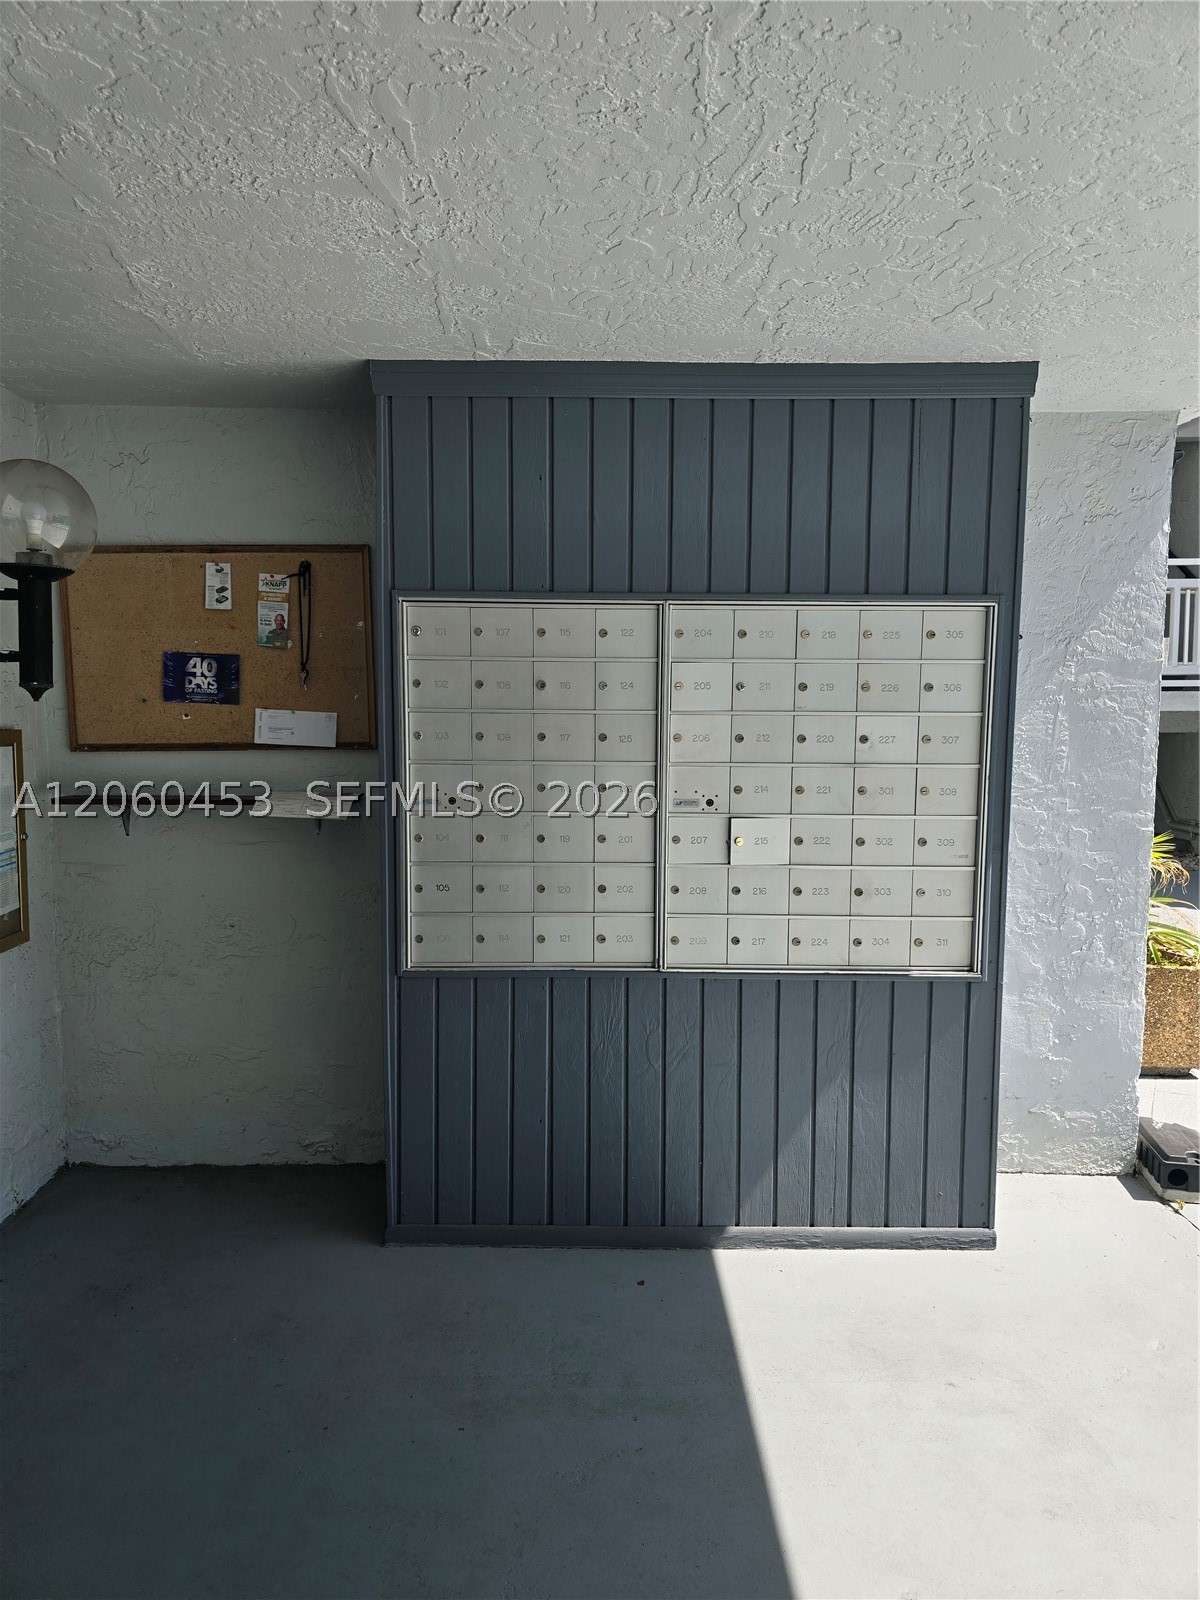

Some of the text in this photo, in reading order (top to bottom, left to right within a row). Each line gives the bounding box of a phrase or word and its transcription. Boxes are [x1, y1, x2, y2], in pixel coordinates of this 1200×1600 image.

[265, 581, 287, 589] KNAPP
[435, 628, 446, 636] 101
[496, 628, 510, 636] 107
[560, 629, 571, 637] 115
[621, 629, 634, 637] 122
[693, 629, 712, 638] 204
[758, 630, 773, 639] 210
[821, 631, 836, 639] 218
[882, 631, 901, 639] 225
[945, 630, 964, 639] 305
[185, 657, 218, 677] 40
[185, 676, 218, 689] DAYS
[434, 680, 448, 688] 102
[496, 681, 511, 689] 108
[560, 682, 571, 690] 116
[620, 682, 634, 690] 124
[693, 682, 711, 690] 205
[758, 682, 770, 691] 211
[819, 683, 834, 691] 219
[881, 684, 899, 692] 226
[943, 684, 962, 692] 306
[435, 732, 449, 740] 103
[497, 733, 511, 741] 109
[619, 735, 632, 743] 125
[692, 734, 710, 742] 206
[756, 734, 770, 742] 212
[816, 735, 834, 743] 220
[878, 735, 896, 743] 227
[941, 736, 959, 744] 307
[754, 785, 769, 793] 214
[816, 786, 831, 794] 221
[878, 787, 894, 795] 301
[938, 787, 957, 795] 308
[500, 834, 508, 842] 111
[560, 835, 571, 843] 119
[618, 835, 633, 843] 201
[690, 836, 708, 844] 207
[754, 837, 769, 845] 215
[813, 837, 831, 845] 222
[875, 837, 893, 846] 302
[937, 838, 955, 846] 309
[436, 884, 450, 892] 105
[616, 885, 633, 893] 202
[689, 887, 707, 895] 208
[752, 887, 767, 895] 216
[812, 887, 830, 895] 223
[873, 888, 891, 896] 303
[936, 888, 951, 896] 310
[616, 935, 633, 943] 203
[689, 937, 707, 945] 209
[811, 938, 828, 946] 224
[936, 938, 948, 946] 311
